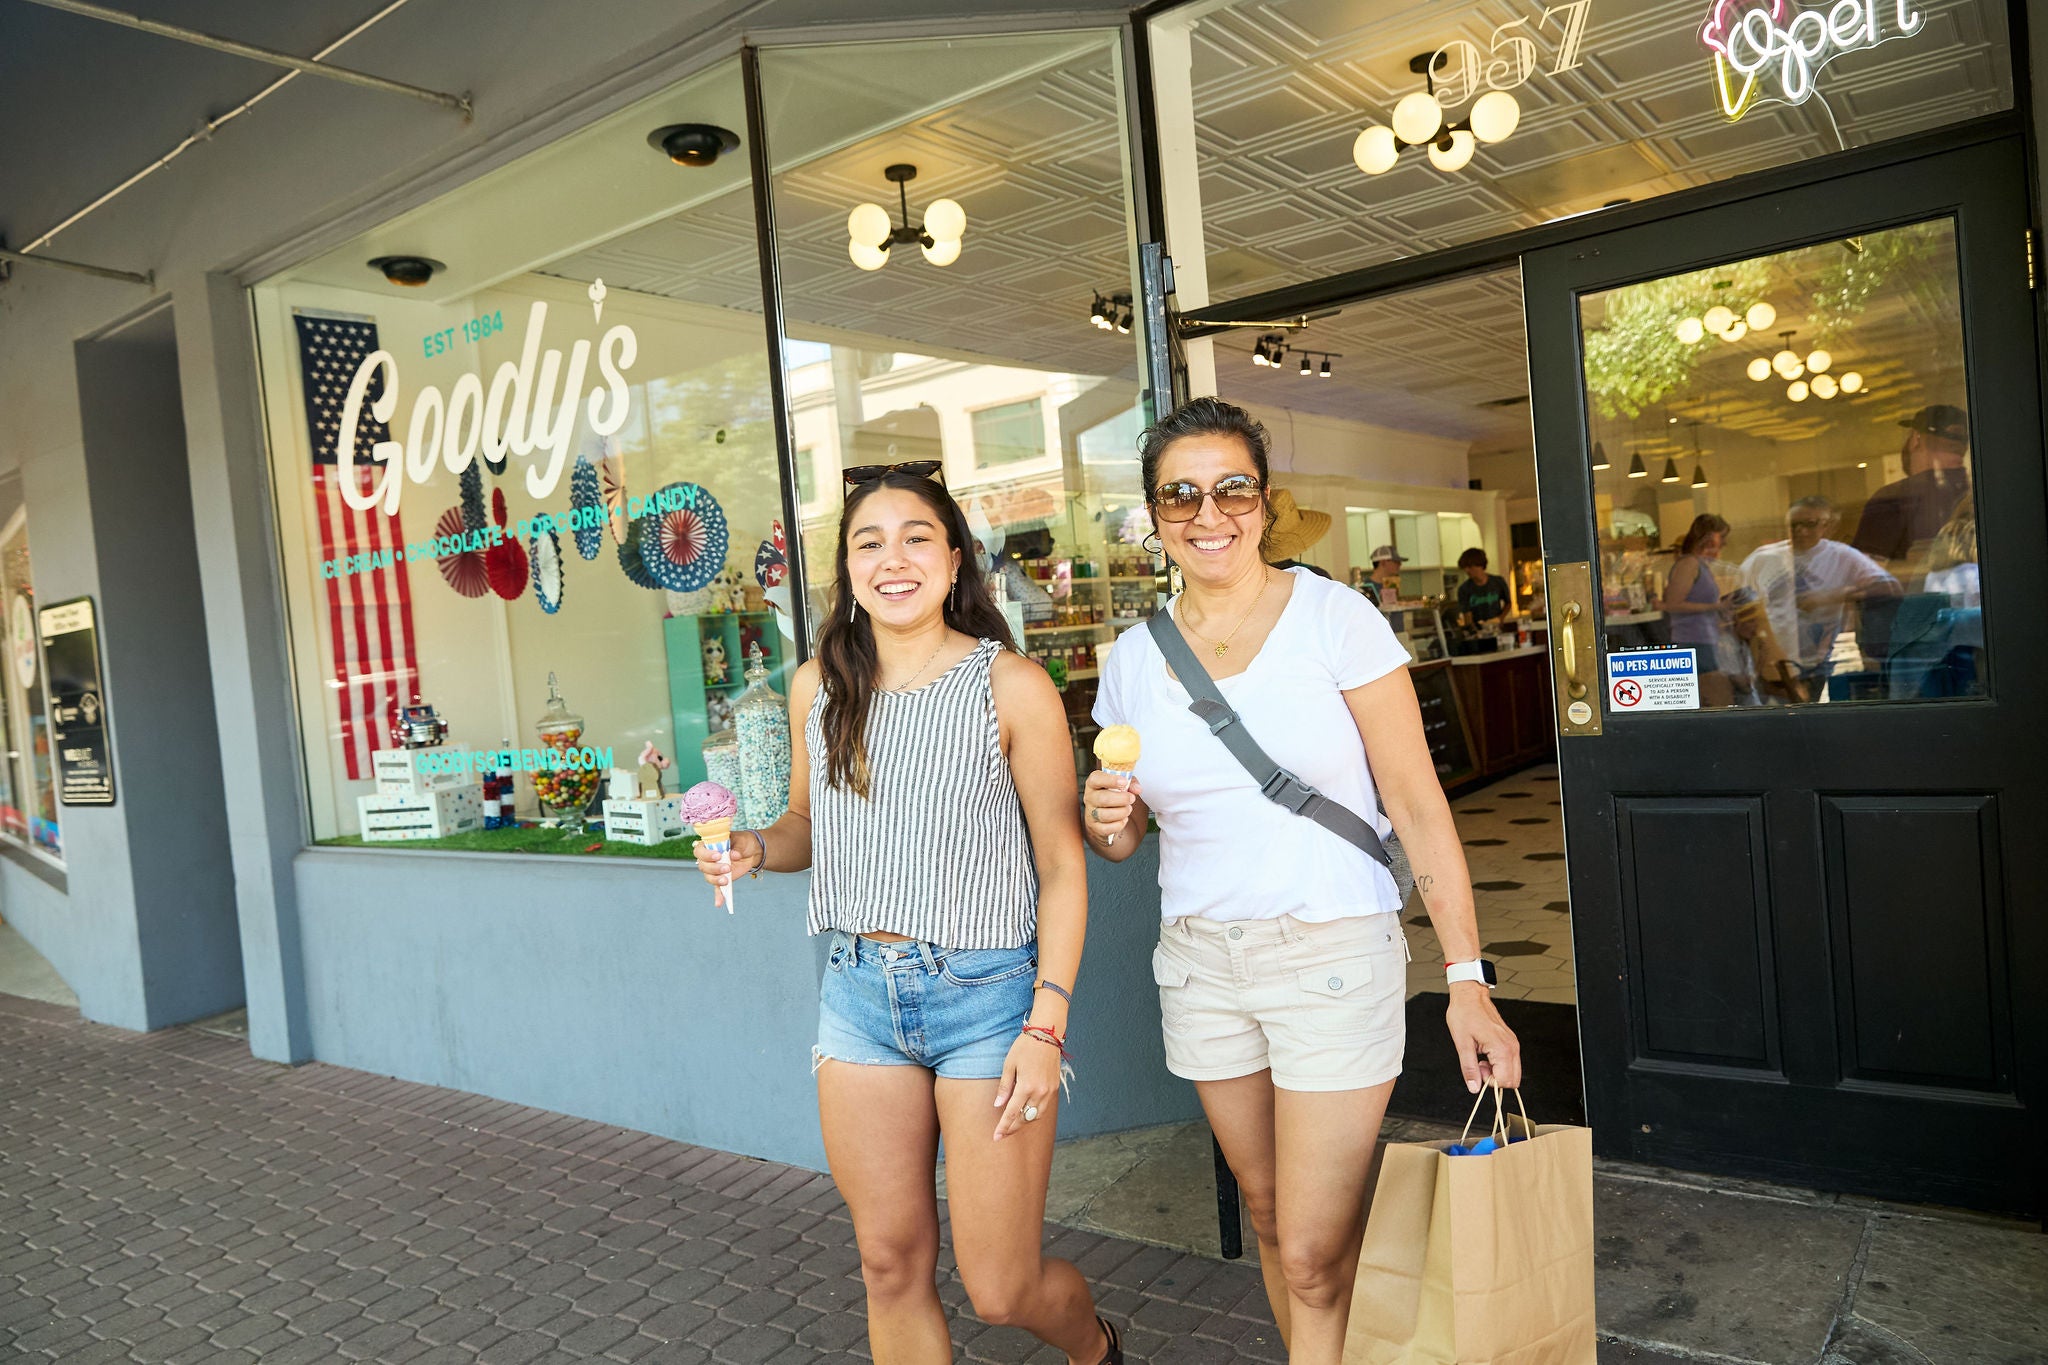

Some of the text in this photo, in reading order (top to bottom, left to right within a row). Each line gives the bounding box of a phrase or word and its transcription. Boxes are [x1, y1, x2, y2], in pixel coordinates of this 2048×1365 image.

[1428, 0, 1592, 108] 957
[1726, 0, 1918, 99] Open
[423, 310, 504, 359] EST 1984
[337, 278, 637, 516] Goody's
[320, 484, 699, 579] ICE CREAM CHOCOLATE POPCORN CANDY
[1612, 657, 1691, 672] NO PETS ALLOWED
[416, 746, 614, 775] GOODYSOFBEND.COM
